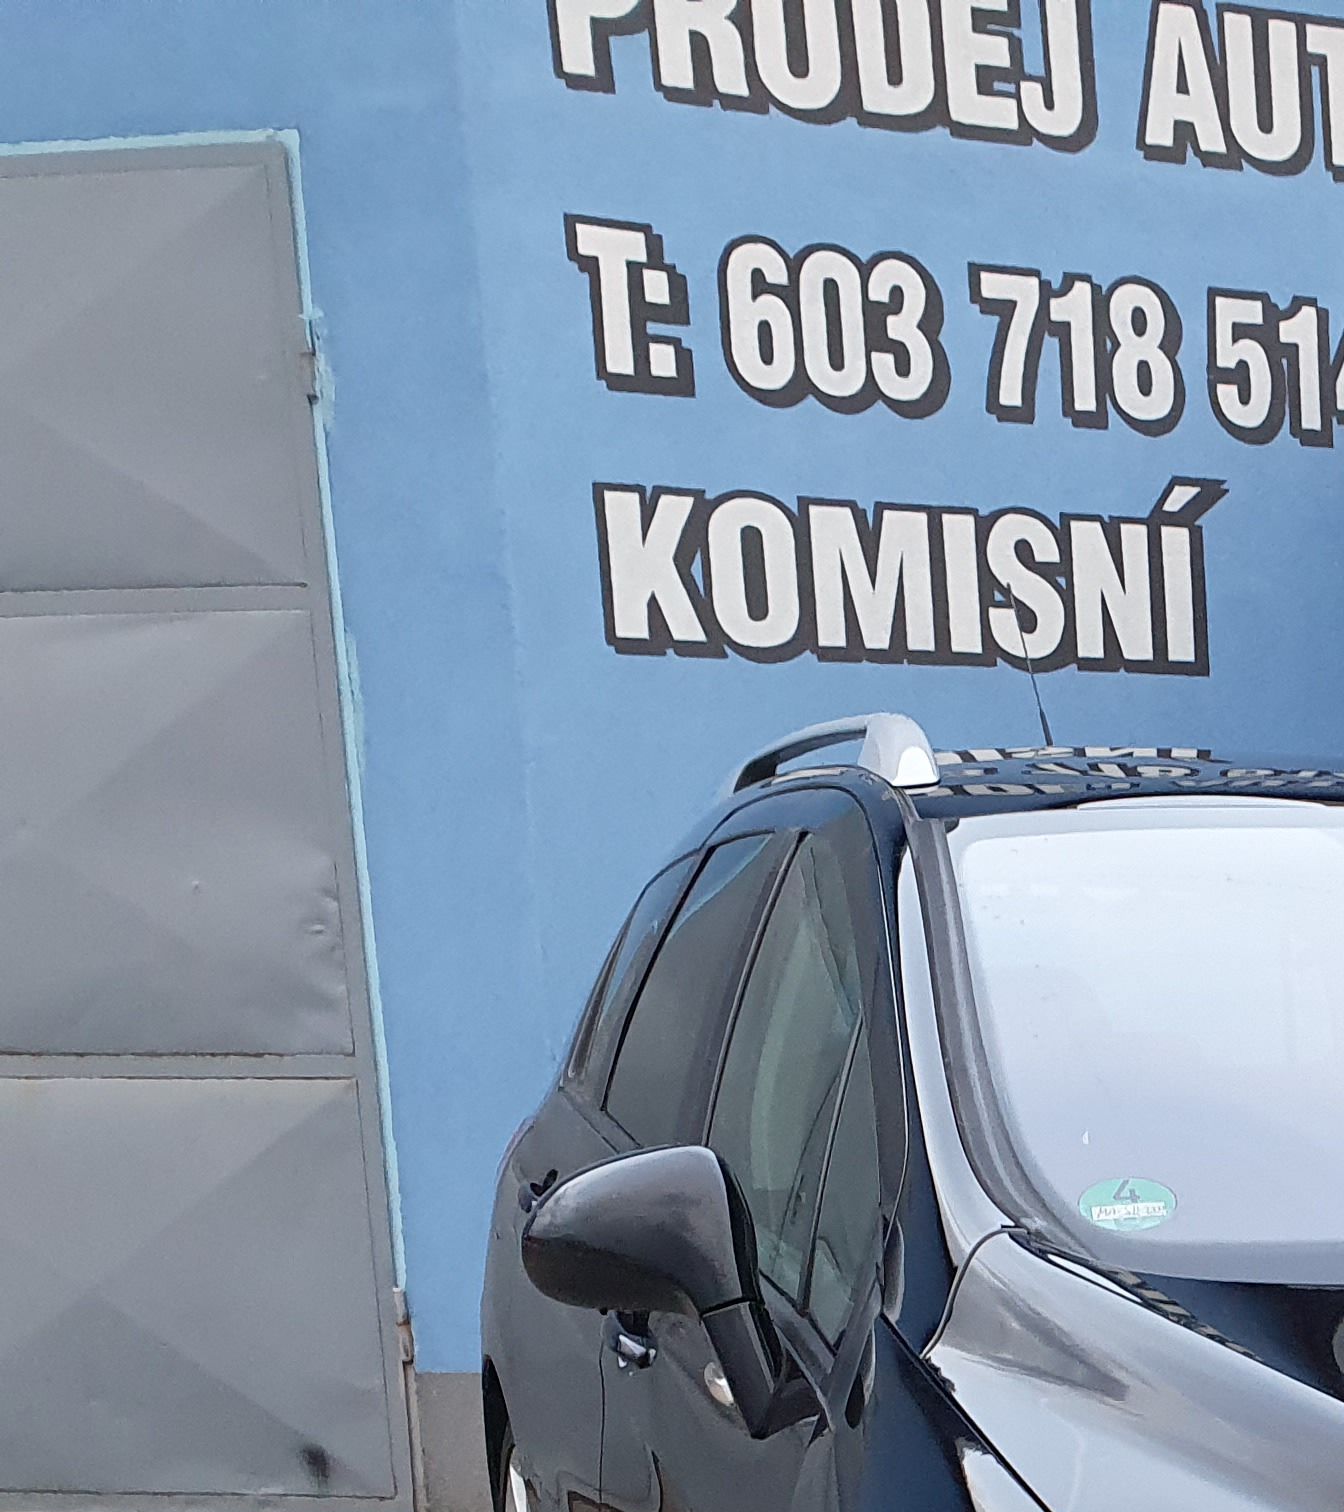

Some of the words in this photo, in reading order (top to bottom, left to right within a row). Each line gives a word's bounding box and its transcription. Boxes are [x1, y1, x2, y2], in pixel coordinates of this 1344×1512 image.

[563, 213, 696, 397] T:
[718, 234, 950, 418] 603
[967, 262, 1187, 424] 718
[592, 477, 1228, 676] KOMISNÍ
